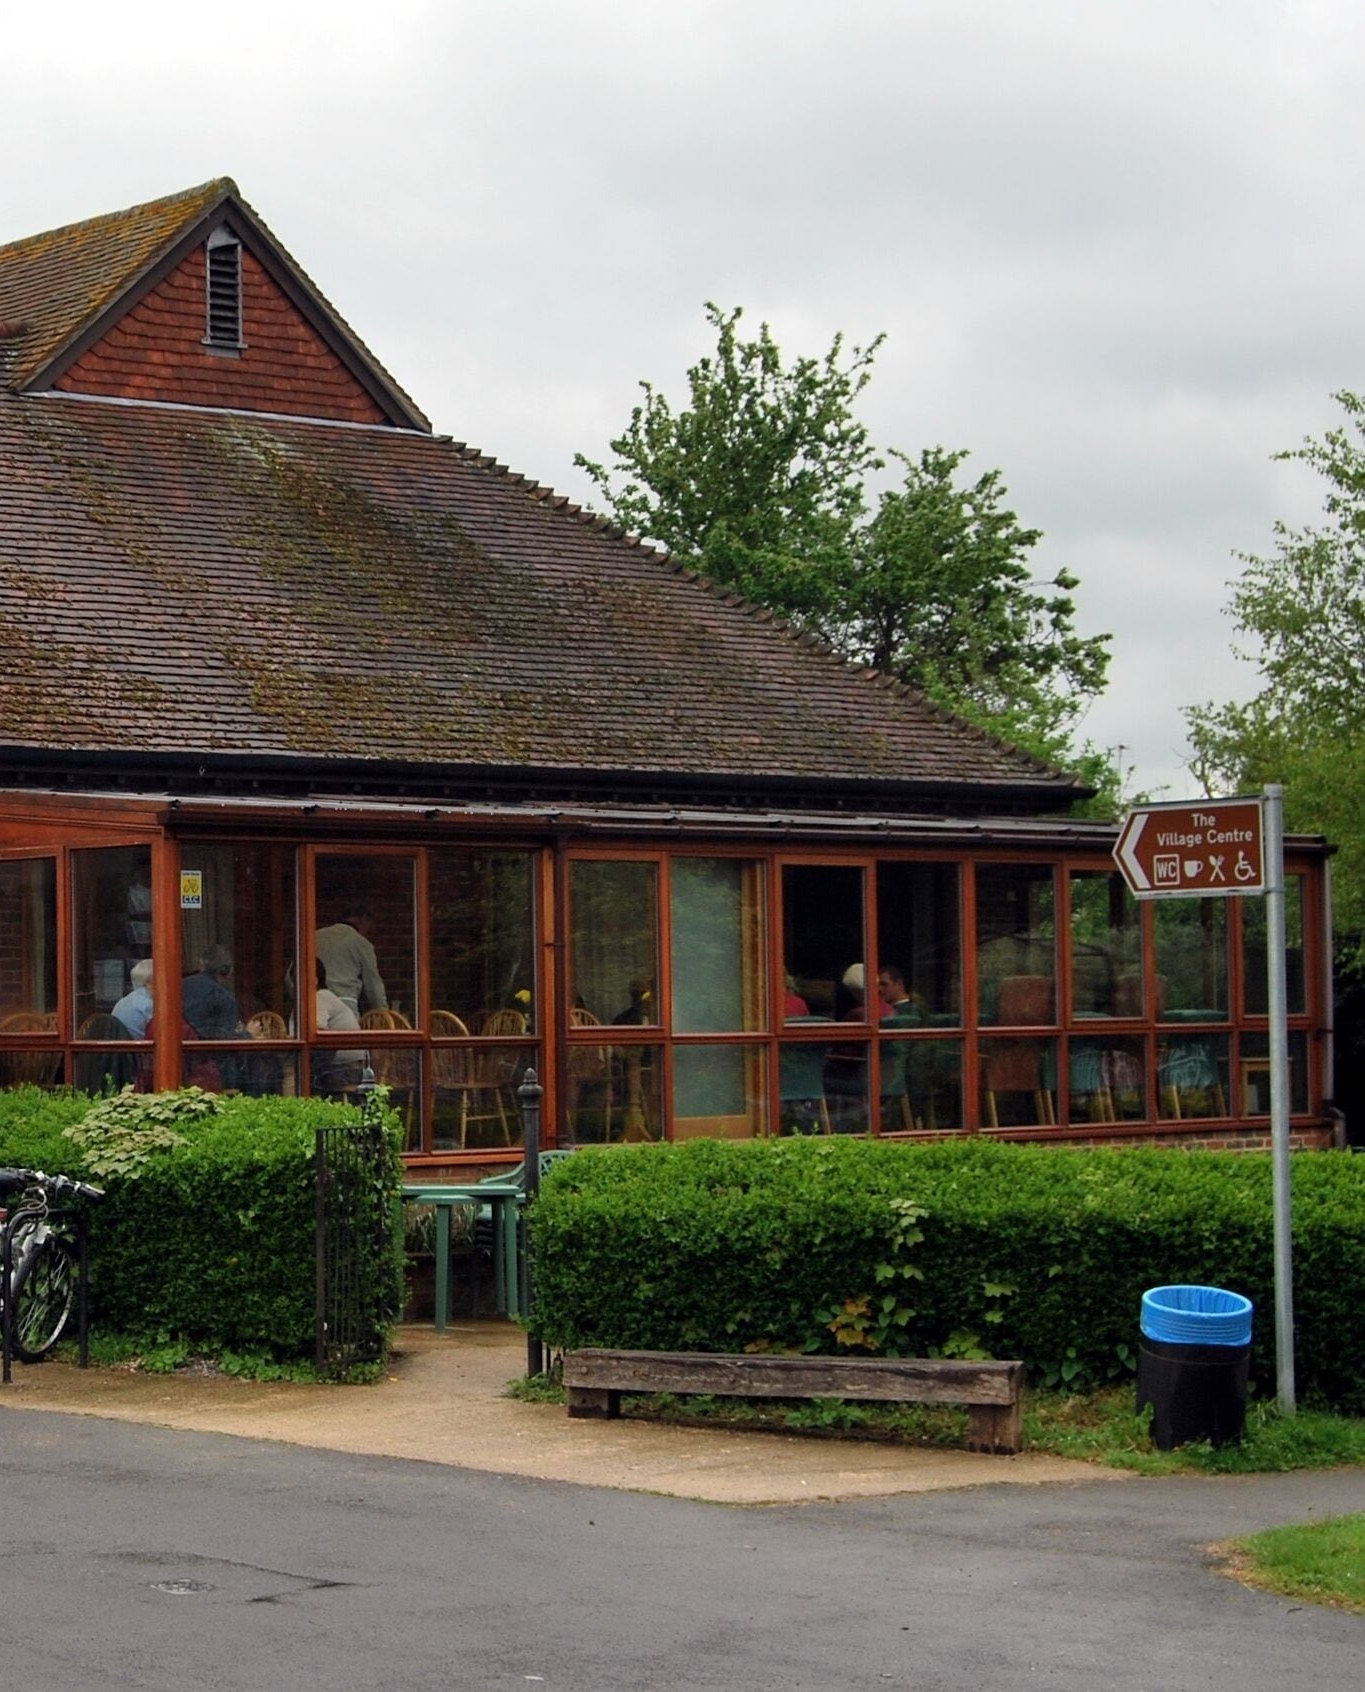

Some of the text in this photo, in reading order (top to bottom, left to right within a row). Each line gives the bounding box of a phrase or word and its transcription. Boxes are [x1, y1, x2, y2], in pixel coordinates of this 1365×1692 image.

[1192, 813, 1216, 827] The
[1157, 829, 1253, 847] Village Centre
[1157, 861, 1176, 878] WC
